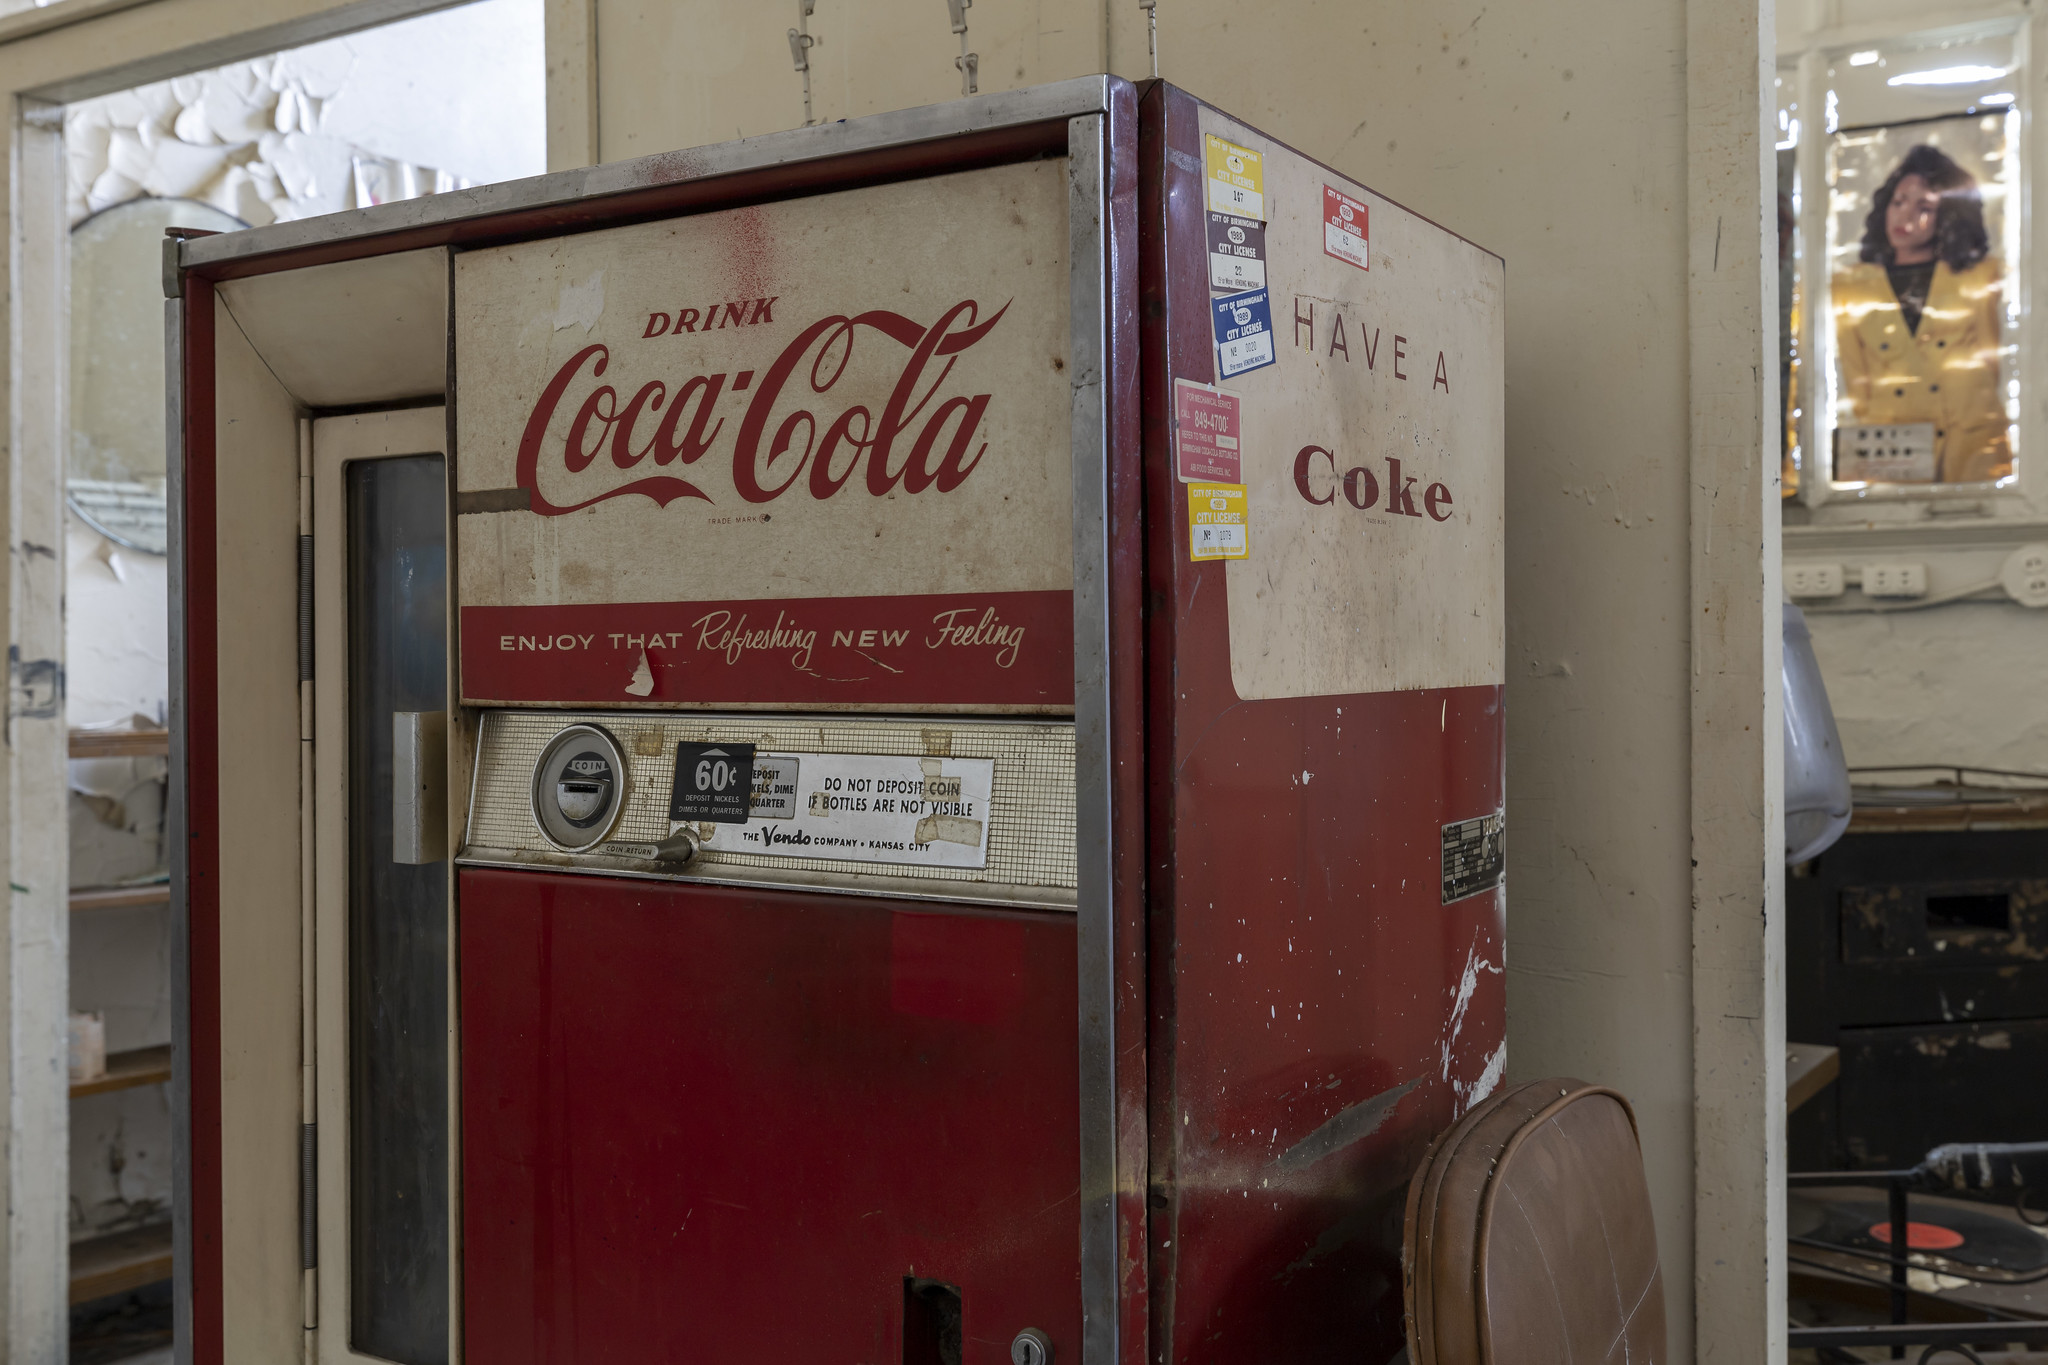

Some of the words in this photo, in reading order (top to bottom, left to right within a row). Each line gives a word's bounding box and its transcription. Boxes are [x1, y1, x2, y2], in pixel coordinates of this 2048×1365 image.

[1211, 139, 1220, 149] CITY
[1217, 169, 1230, 181] CITY
[1232, 174, 1255, 190] LICENSE
[1327, 189, 1335, 198] CITY
[1342, 196, 1365, 213] BIRMINGHAM
[1211, 214, 1222, 222] CITY
[1223, 216, 1229, 224] OF
[1230, 218, 1259, 229] BIRMINGHAM
[1331, 215, 1342, 227] CITY
[1343, 220, 1362, 236] LICENSE
[1230, 230, 1243, 241] 1988
[1218, 242, 1231, 254] CITY
[1233, 245, 1256, 258] LICENSE
[1234, 265, 1242, 276] 22
[1218, 303, 1229, 313] CITY
[1229, 301, 1235, 309] OF
[1236, 294, 1264, 308] BIRMINGHAM
[642, 296, 779, 339] DRINK
[1236, 312, 1249, 322] 1989
[1226, 328, 1240, 340] CITY
[1240, 321, 1262, 336] LICENSE
[1294, 297, 1407, 381] HAVE
[1433, 351, 1449, 394] A
[516, 296, 1014, 516] Coca-Cola
[1186, 392, 1194, 401] FOR
[1195, 394, 1217, 407] MECHANICAL
[1217, 399, 1232, 410] SERVICE
[1181, 409, 1190, 419] CALL
[1181, 430, 1193, 440] REFER
[1194, 432, 1199, 440] TO
[1199, 433, 1207, 442] THIS
[1197, 464, 1207, 473] FOOD
[1293, 444, 1453, 522] Coke
[1193, 489, 1204, 497] CITY
[1212, 489, 1243, 498] BIRMINGHAM
[708, 517, 731, 525] TRADE
[1196, 512, 1212, 524] CITY
[1213, 512, 1241, 523] LICENSE
[500, 634, 595, 651] ENJOY
[607, 632, 683, 650] THAT
[692, 610, 817, 670] Refreshing
[832, 630, 910, 648] NEW
[925, 607, 1026, 669] Feeling
[575, 761, 602, 770] COIN
[695, 759, 737, 792] 60¢
[752, 769, 780, 780] EPOSIT
[774, 784, 795, 794] DIME
[824, 777, 842, 791] DO
[847, 778, 872, 792] NOT
[877, 780, 924, 795] DEPOSIT
[929, 782, 960, 796] COIN
[685, 794, 710, 802] DEPOSIT
[714, 795, 740, 803] NICKELS
[808, 795, 818, 809] IF
[822, 795, 867, 812] BOTTLES
[872, 799, 895, 813] ARE
[900, 800, 925, 814] NOT
[931, 801, 973, 817] VISIBLE
[678, 805, 698, 813] DIMES
[711, 807, 743, 815] QUARTERS
[743, 832, 760, 841] THE
[761, 824, 811, 847] Vendo
[814, 836, 858, 847] COMPANY
[869, 840, 904, 851] KANSAS
[908, 842, 931, 852] CITY
[606, 845, 624, 853] COIN
[626, 847, 652, 856] RETURN
